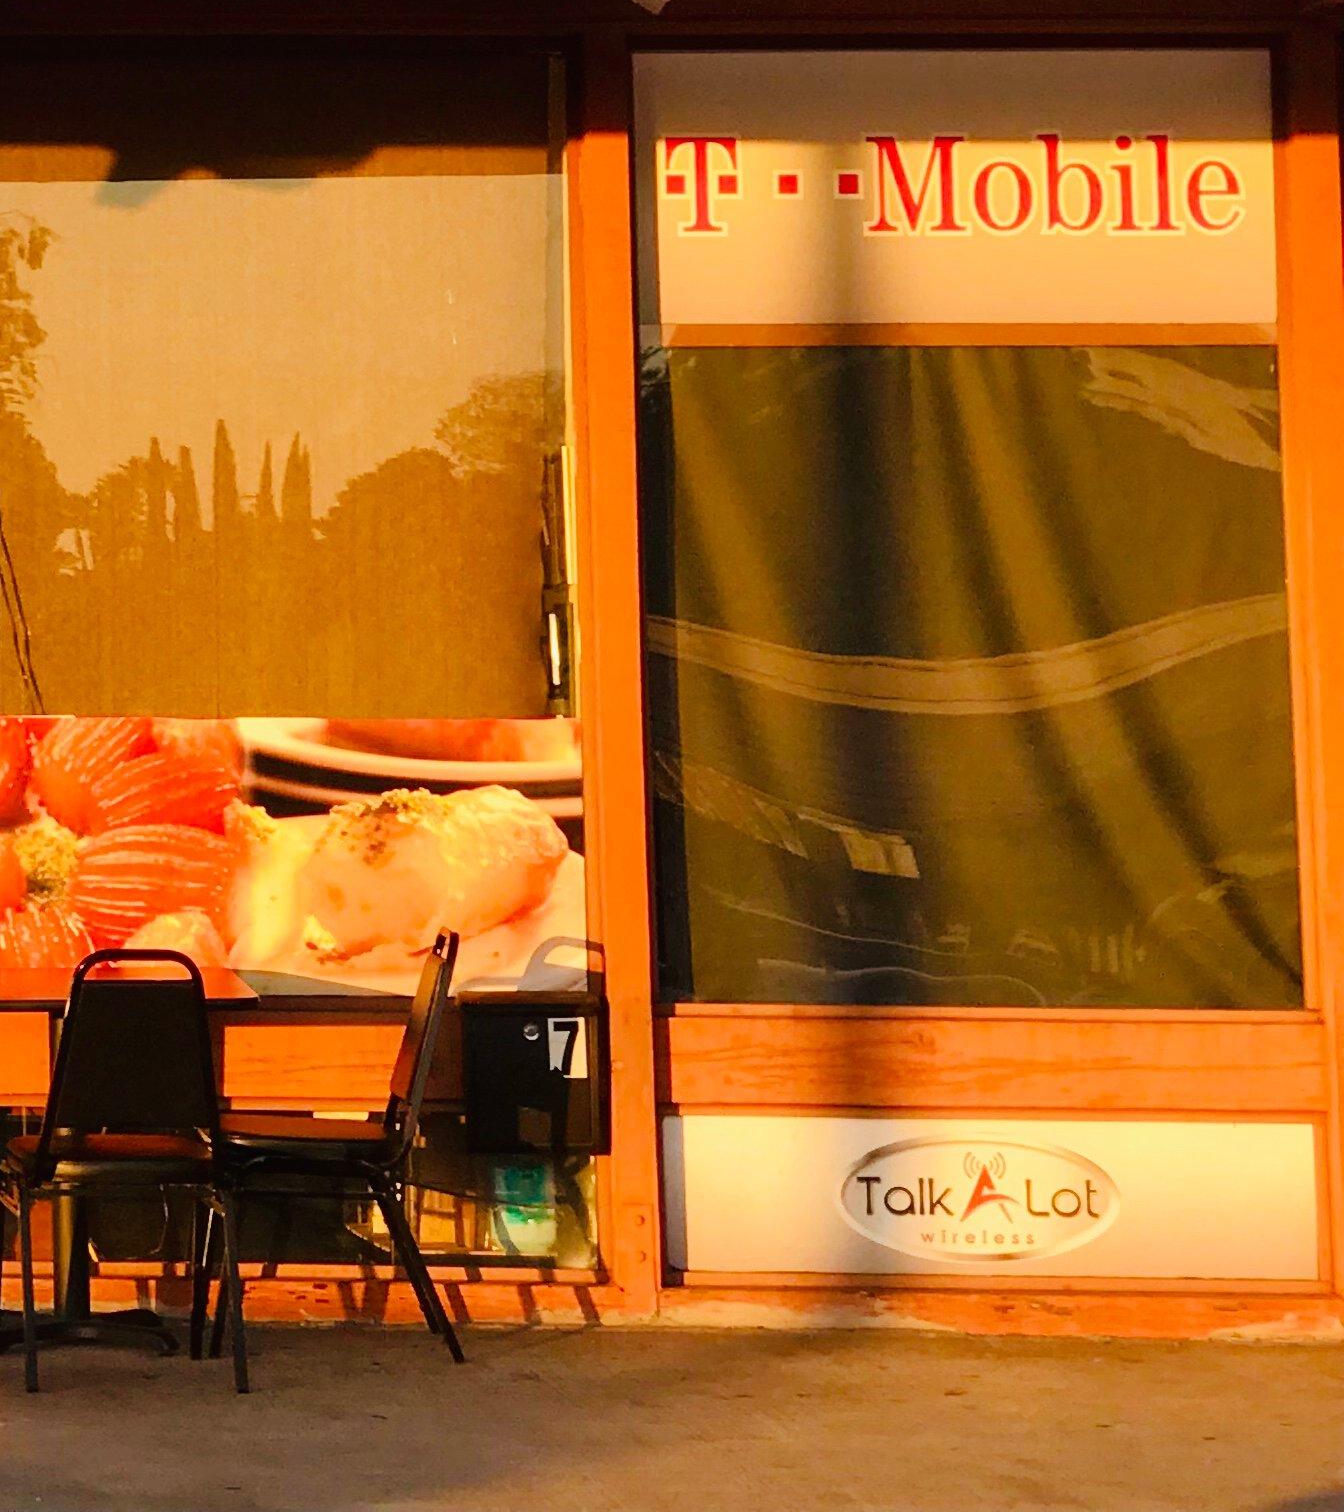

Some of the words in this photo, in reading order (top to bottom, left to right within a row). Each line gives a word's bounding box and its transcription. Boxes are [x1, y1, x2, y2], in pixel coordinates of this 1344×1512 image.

[553, 1021, 580, 1076] 7
[856, 1176, 954, 1217] Talk
[1025, 1178, 1100, 1219] Lot
[920, 1230, 1035, 1245] wireless
